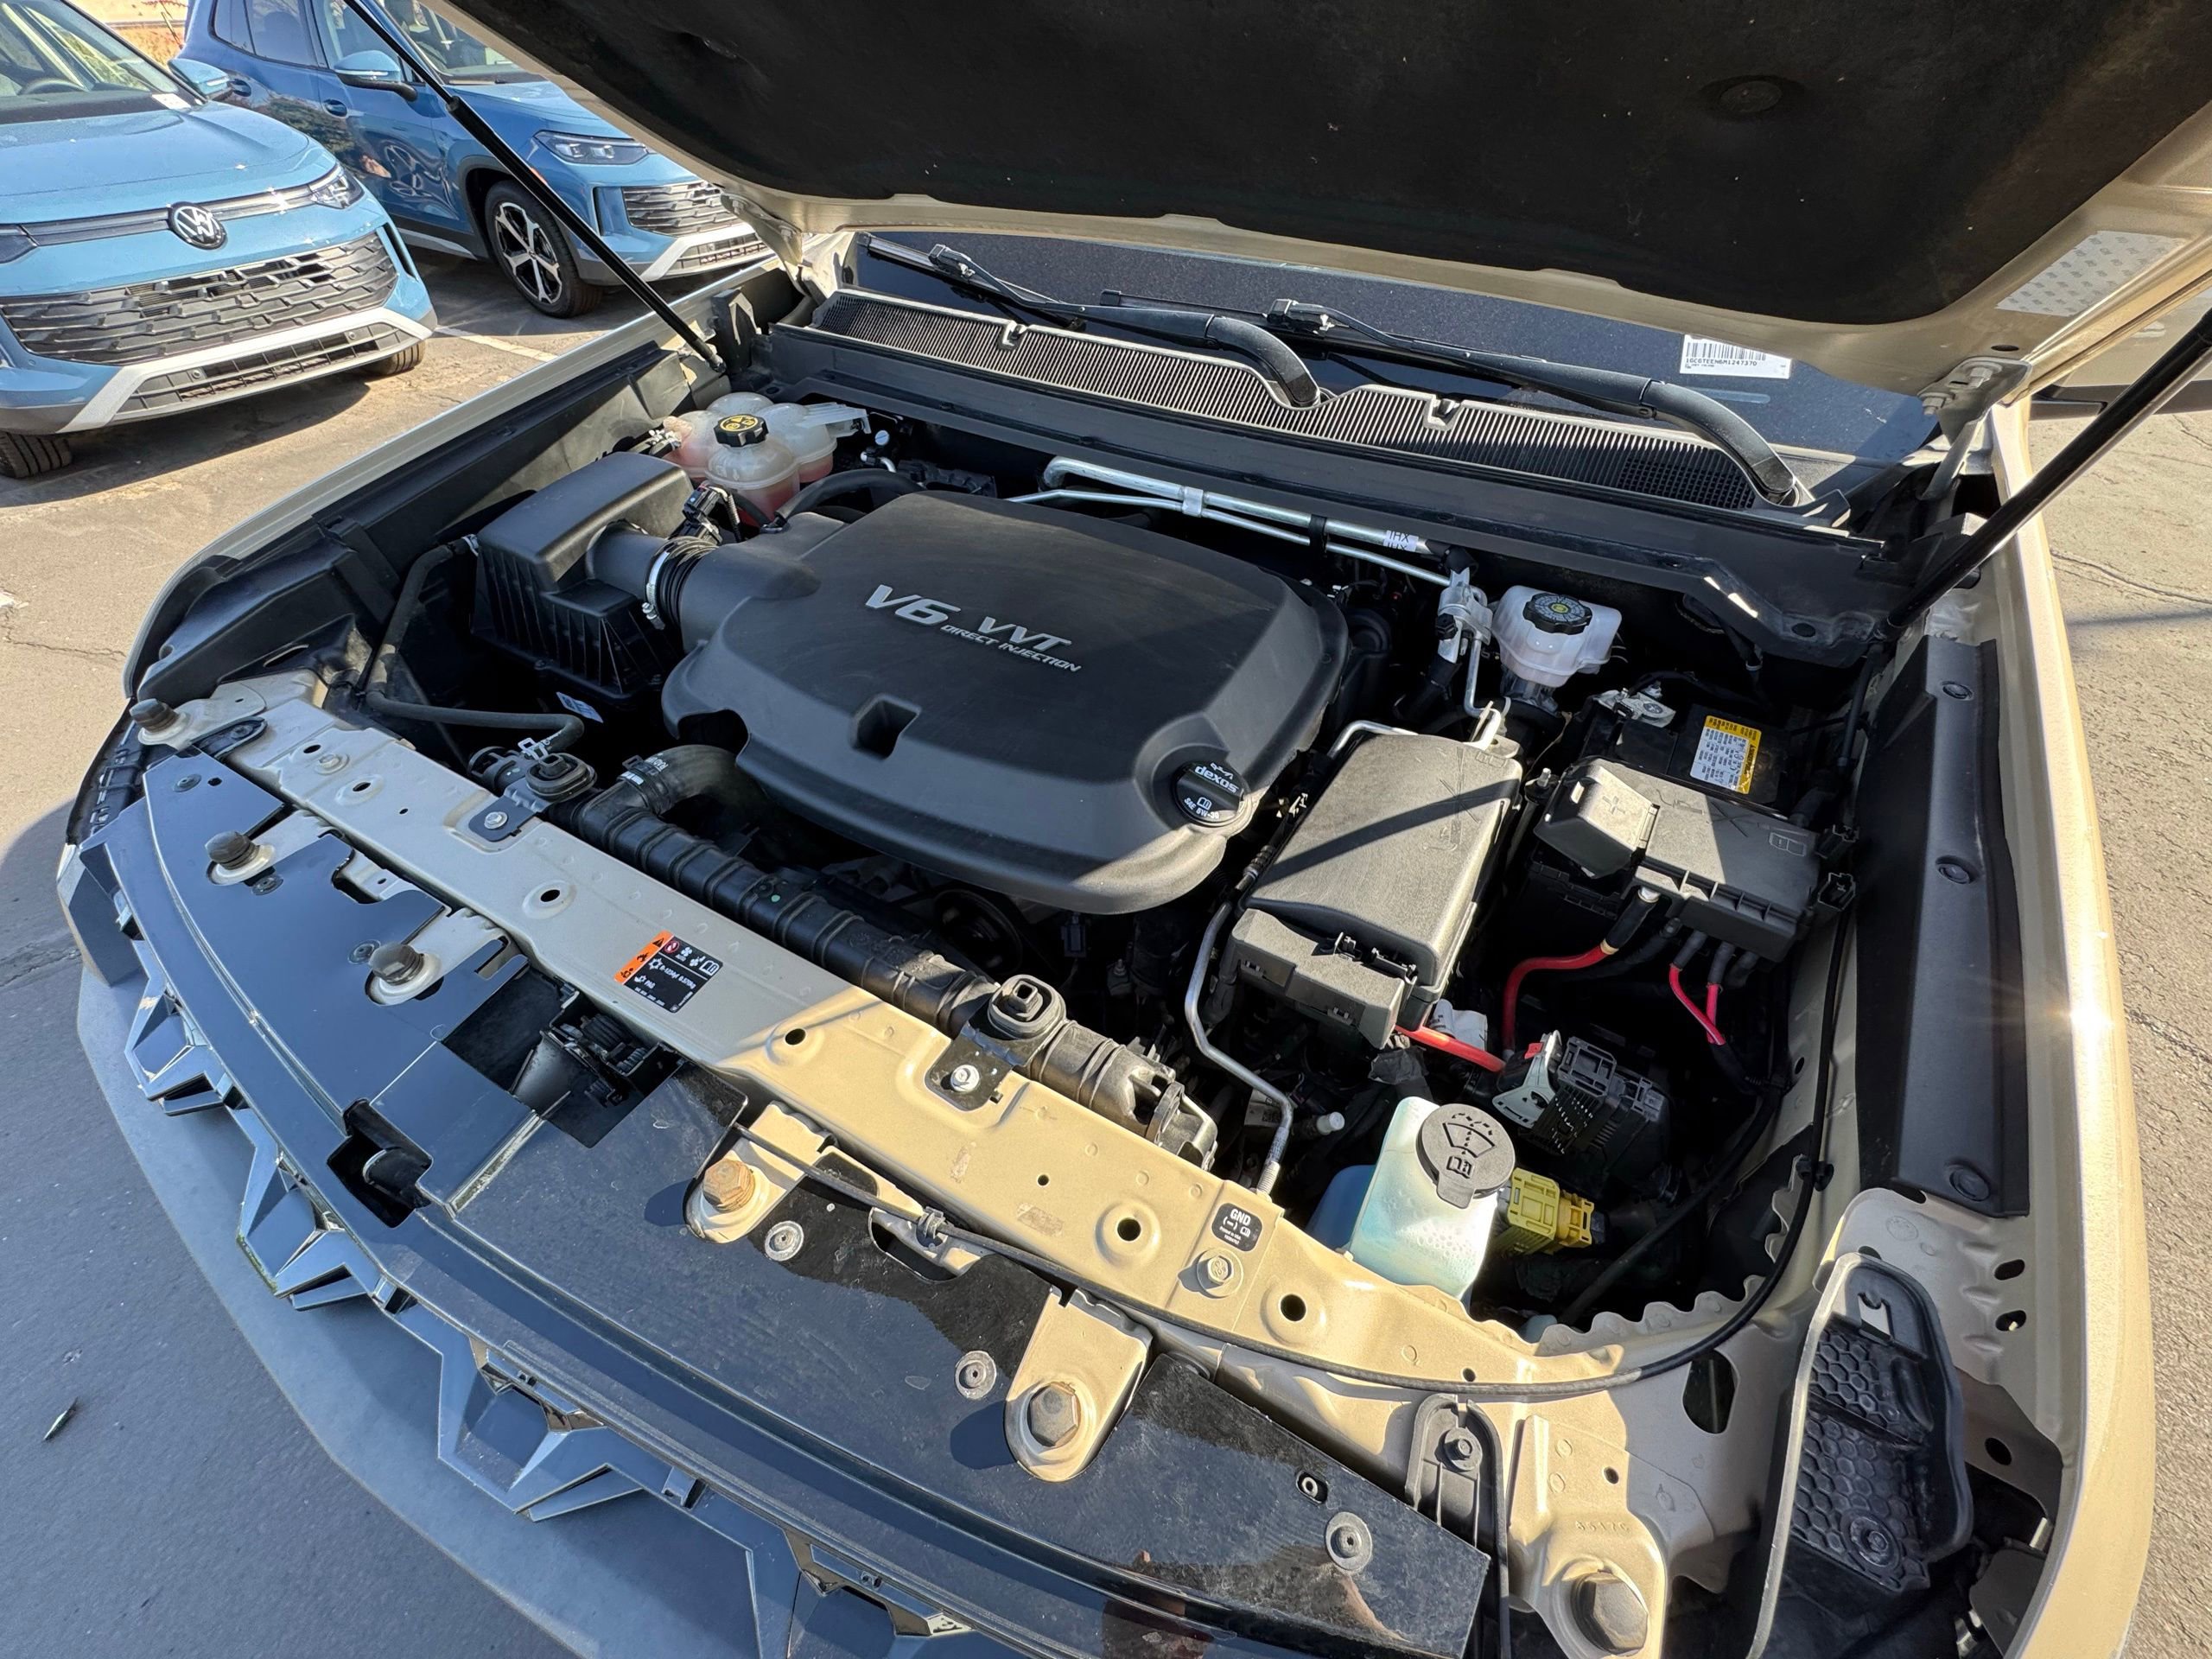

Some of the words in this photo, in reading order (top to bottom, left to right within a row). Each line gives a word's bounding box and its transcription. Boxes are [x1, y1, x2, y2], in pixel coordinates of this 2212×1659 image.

[865, 584, 962, 626] V6
[977, 616, 1071, 652] VVT
[940, 625, 1000, 646] DIRECT
[998, 642, 1082, 672] INJECTION
[1194, 766, 1239, 794] dexos
[1230, 1209, 1251, 1225] GND
